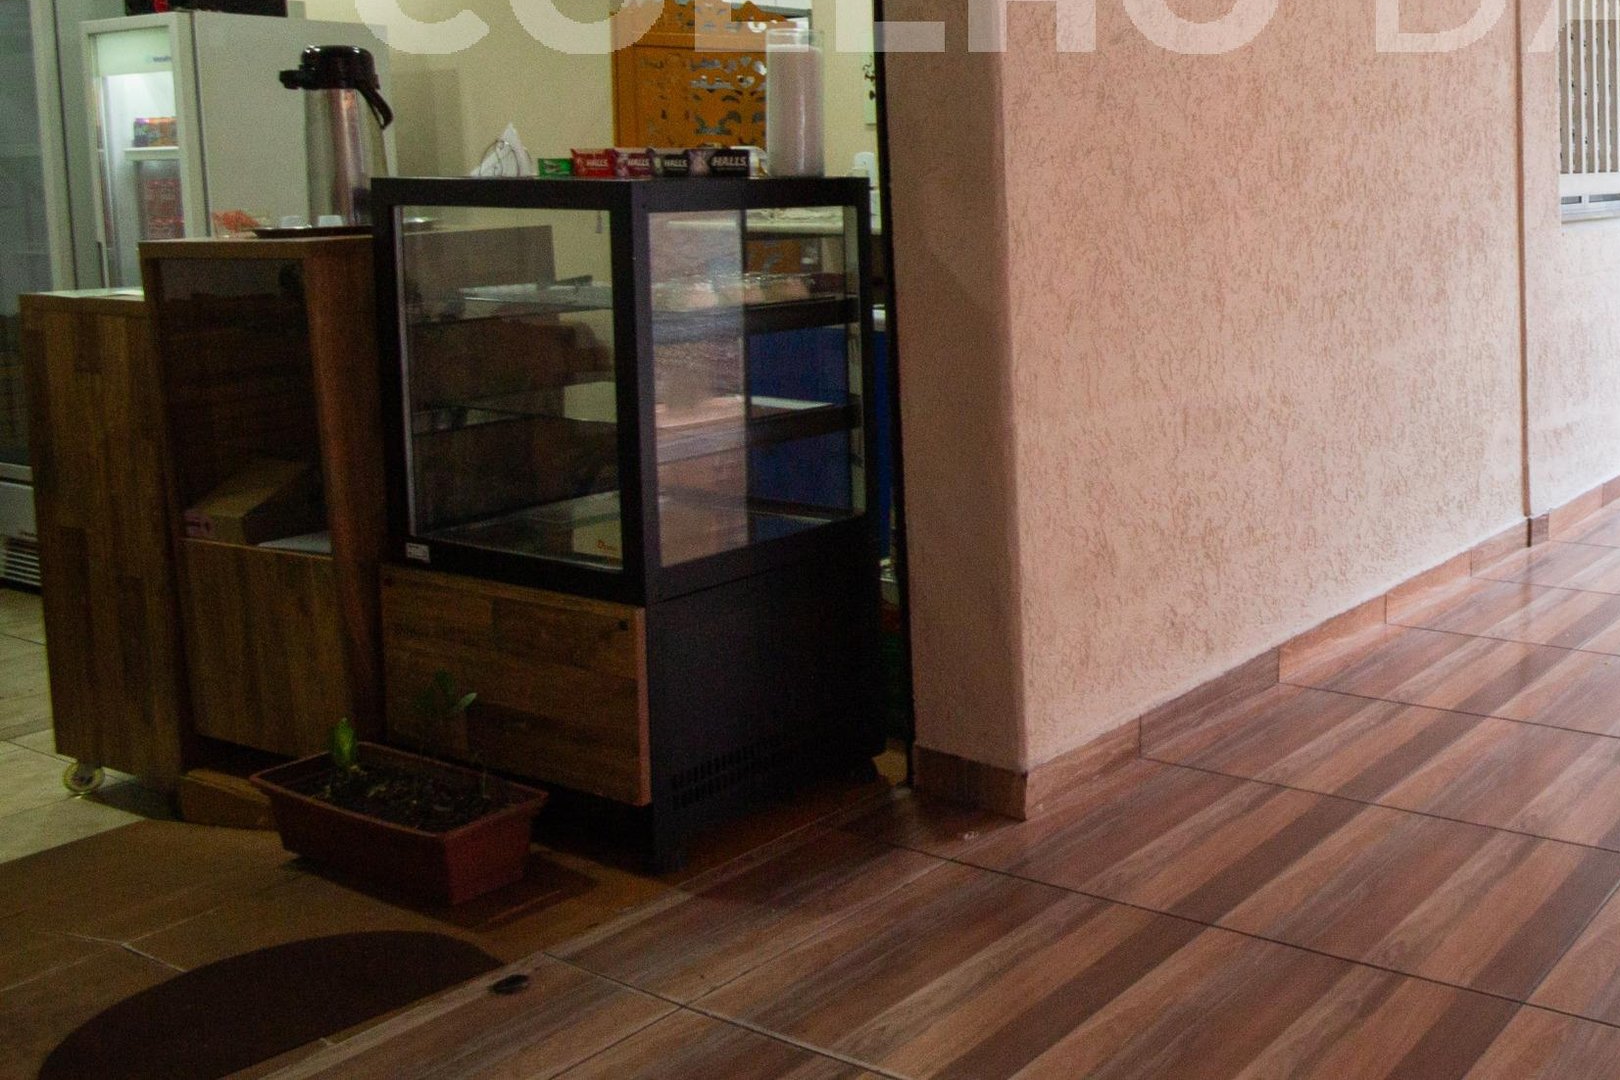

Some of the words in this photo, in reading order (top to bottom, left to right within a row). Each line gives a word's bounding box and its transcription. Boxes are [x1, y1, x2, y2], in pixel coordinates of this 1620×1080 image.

[586, 158, 609, 168] HALLS
[627, 158, 650, 167] HALLS
[664, 159, 689, 168] HALLS
[711, 156, 748, 167] HALLS
